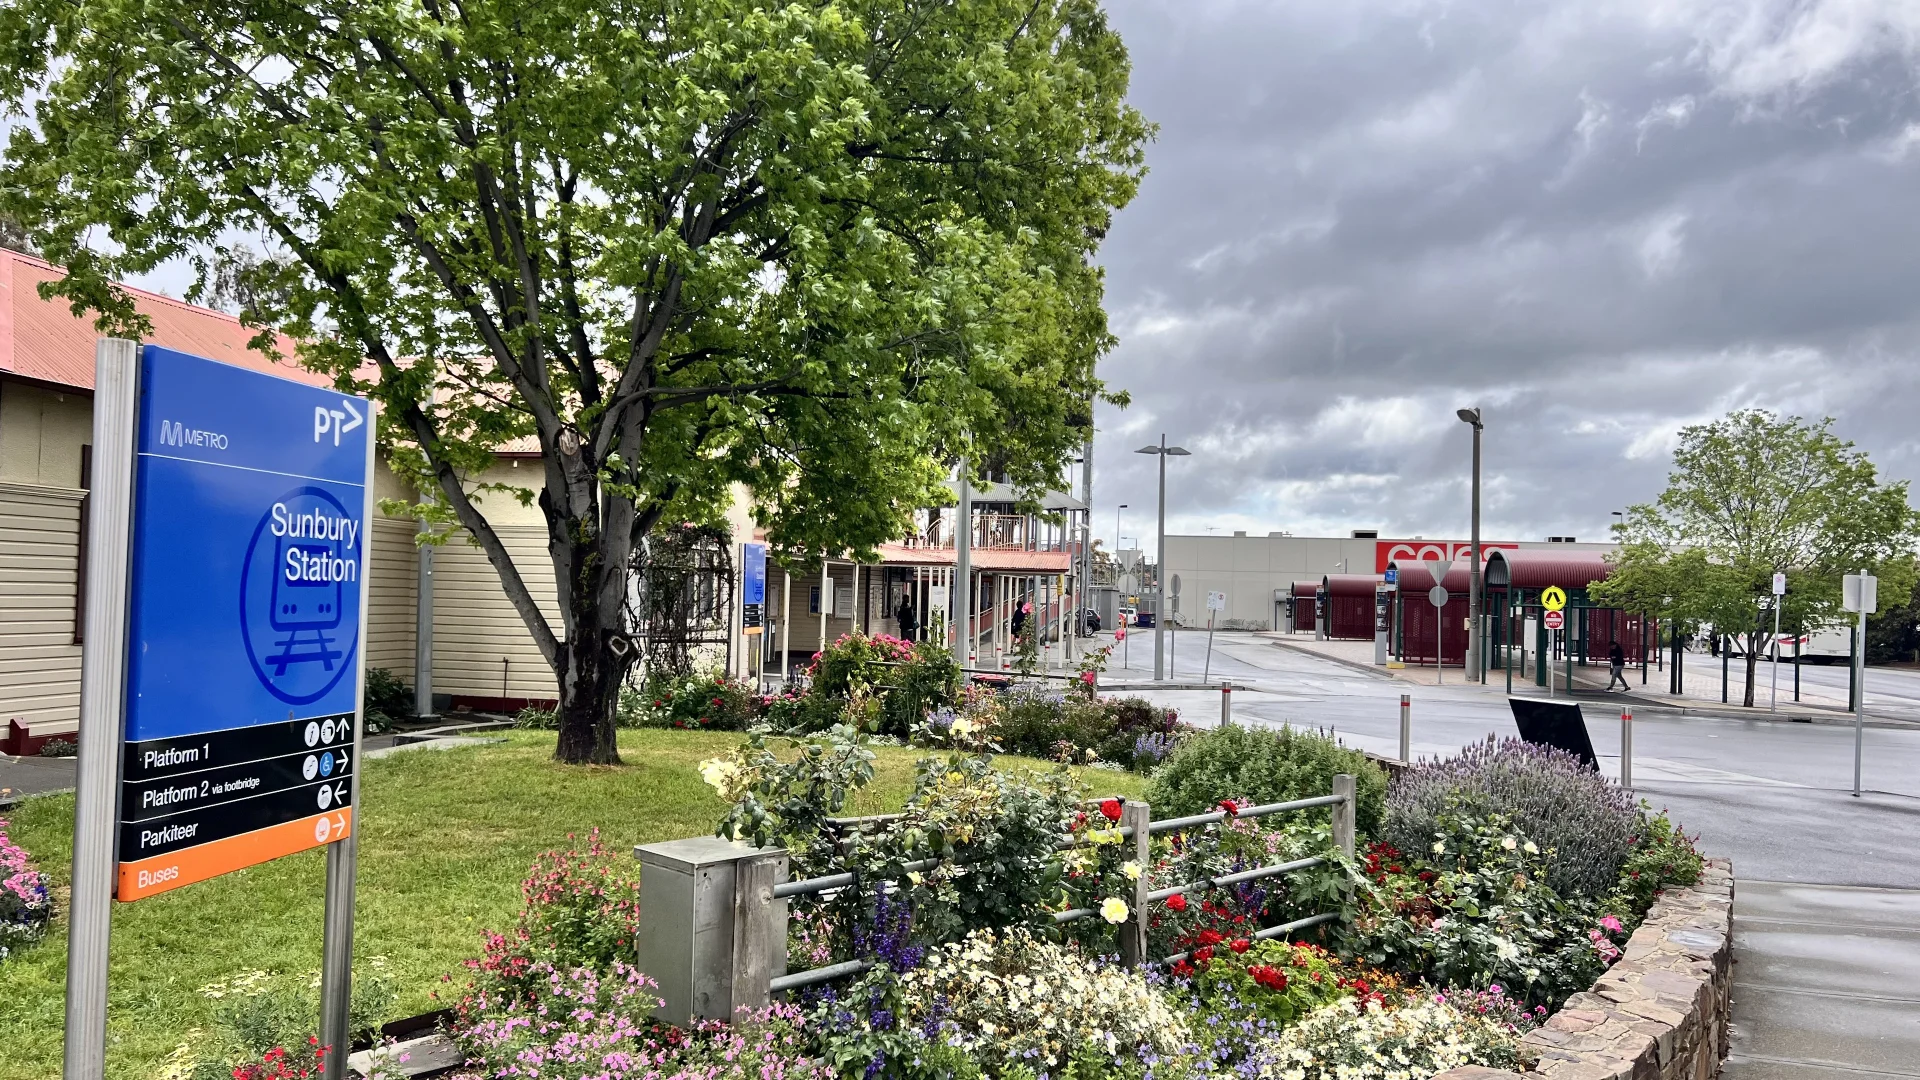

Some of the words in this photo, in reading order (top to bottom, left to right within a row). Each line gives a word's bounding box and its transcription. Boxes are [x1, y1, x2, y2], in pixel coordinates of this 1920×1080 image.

[184, 429, 228, 450] METRO
[270, 502, 358, 549] Sunbury
[285, 547, 356, 581] Station
[144, 748, 199, 769] Platform
[203, 743, 210, 760] 1
[143, 786, 197, 808] Platform
[200, 781, 209, 798] 2
[211, 783, 223, 795] via
[224, 776, 261, 793] footbridge
[141, 823, 198, 848] Parkiteer
[137, 865, 179, 888] Buses
